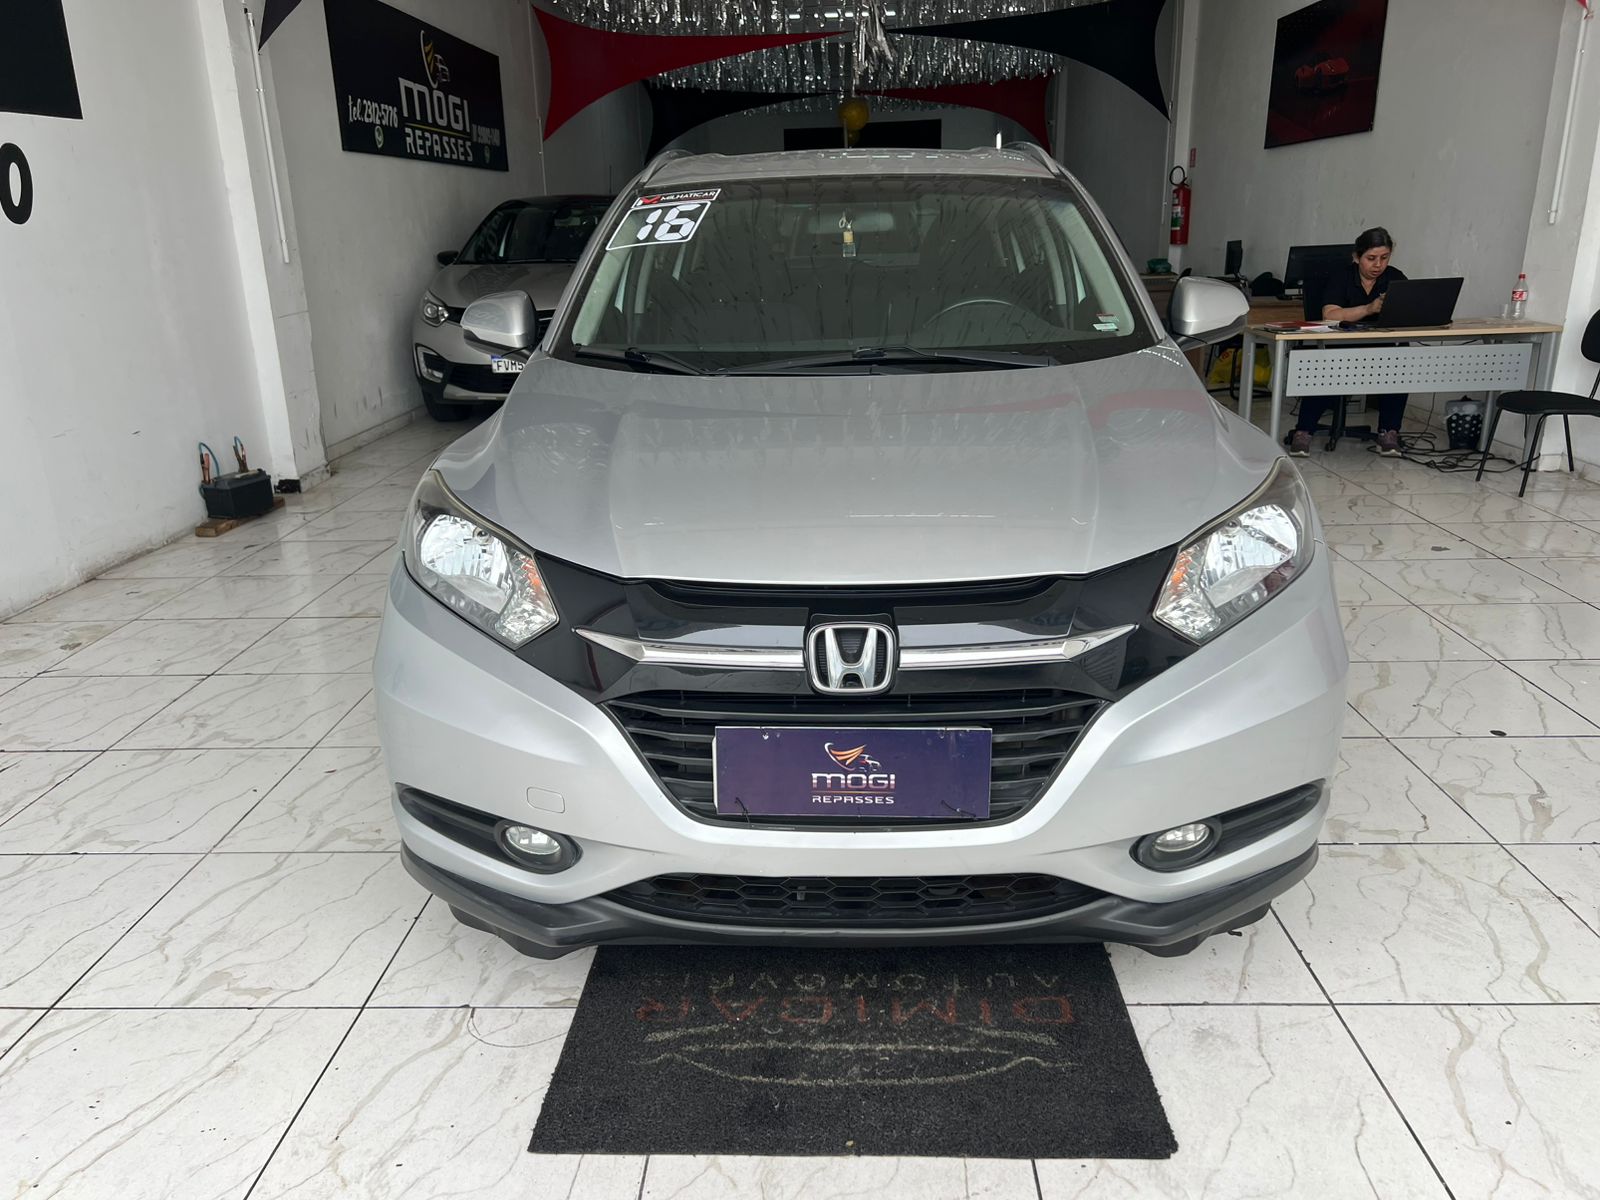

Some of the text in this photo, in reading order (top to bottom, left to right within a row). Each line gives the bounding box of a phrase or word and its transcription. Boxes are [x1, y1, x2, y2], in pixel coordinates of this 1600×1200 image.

[398, 77, 470, 133] MOGI
[405, 127, 473, 162] REPASSES
[636, 203, 702, 241] 16
[811, 773, 896, 789] MOGI
[812, 795, 895, 804] REPASSES
